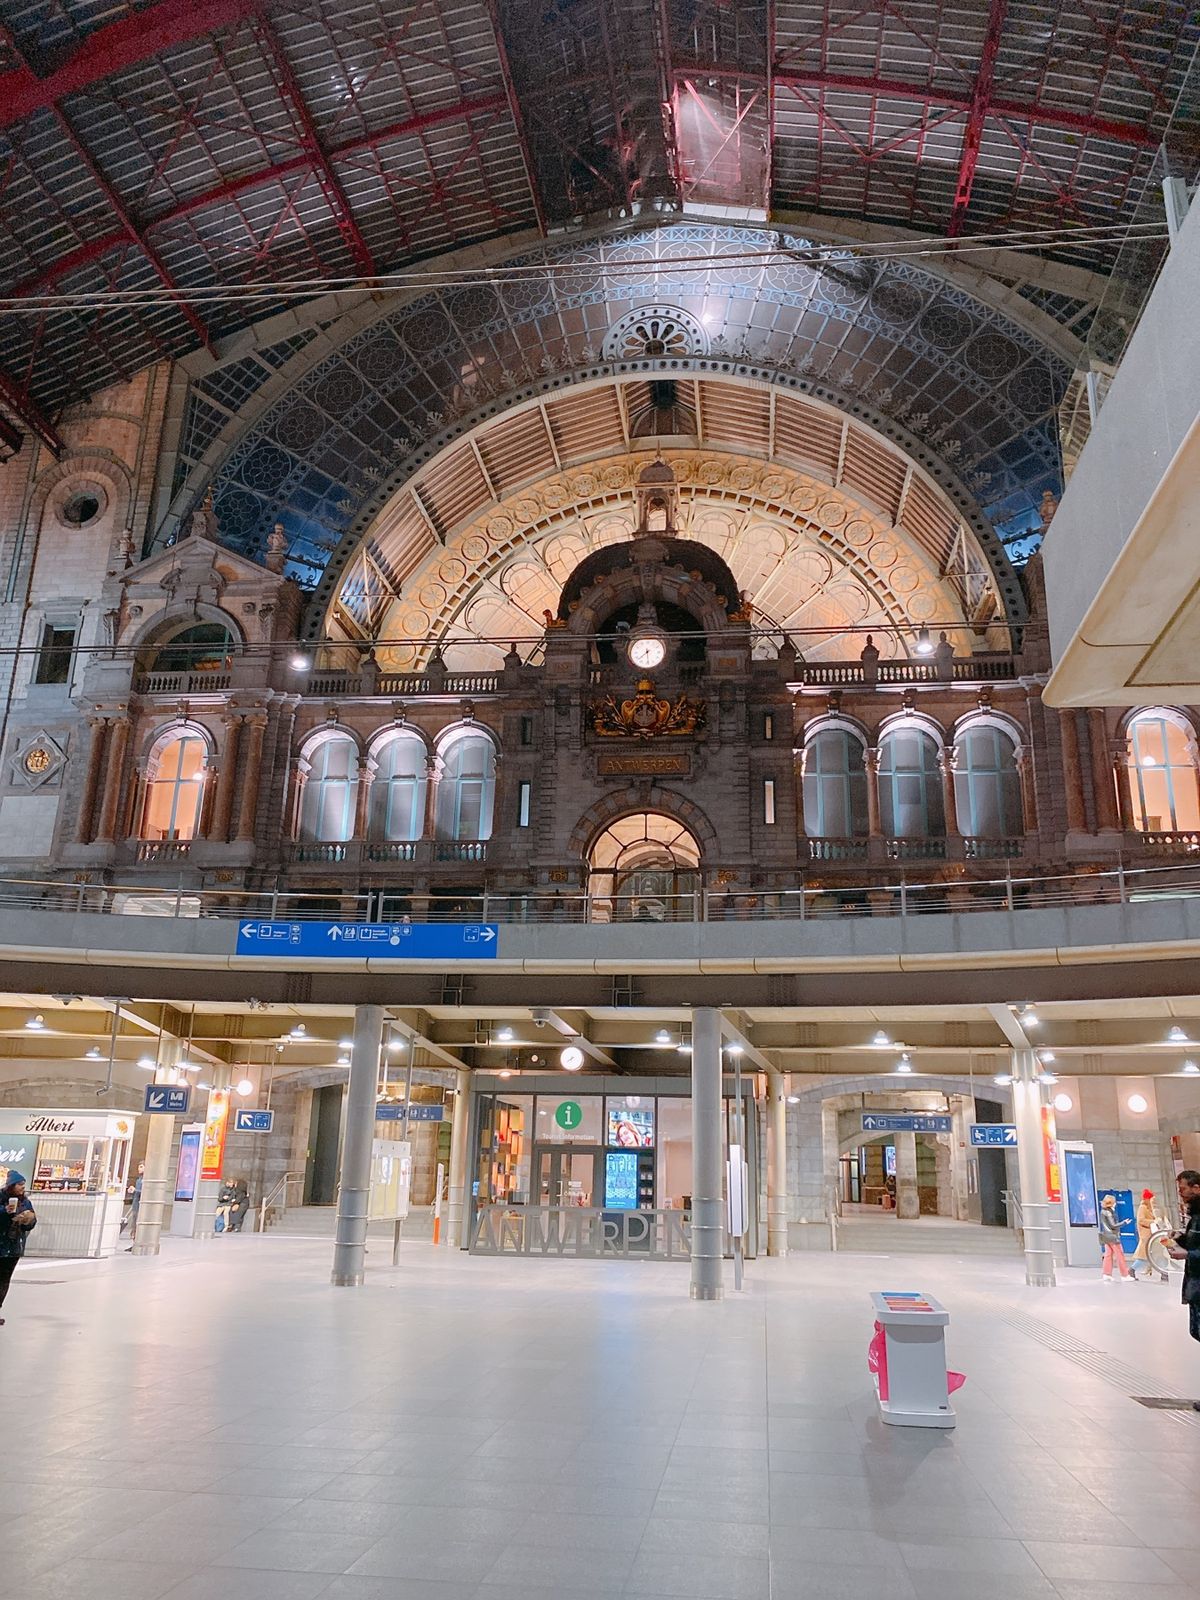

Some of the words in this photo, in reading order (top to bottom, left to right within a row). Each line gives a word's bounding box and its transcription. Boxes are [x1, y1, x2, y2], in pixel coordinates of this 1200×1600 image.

[607, 759, 680, 771] ANTWERPEN
[170, 1092, 183, 1101] M
[25, 1117, 75, 1132] Albert
[0, 1145, 26, 1162] ert
